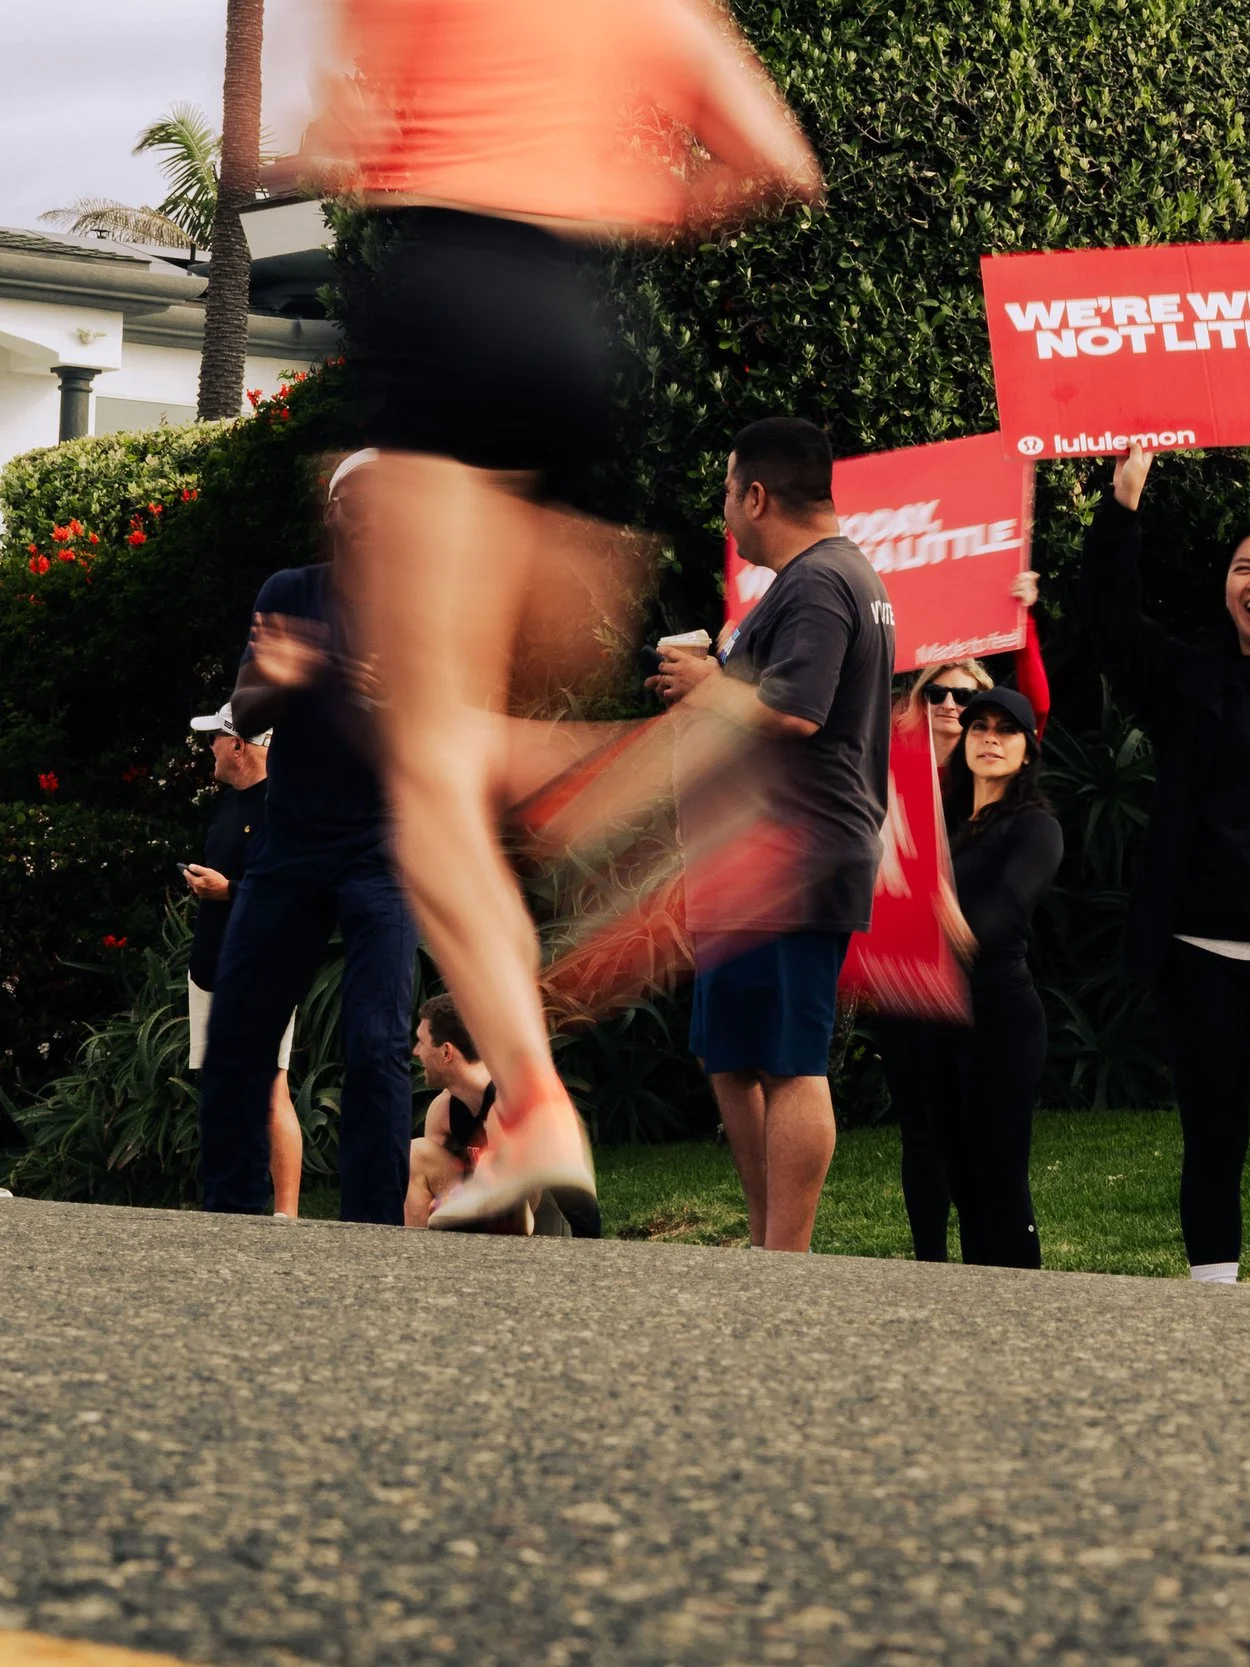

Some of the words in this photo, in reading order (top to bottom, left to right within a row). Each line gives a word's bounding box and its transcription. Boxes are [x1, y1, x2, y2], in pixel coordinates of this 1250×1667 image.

[1004, 296, 1184, 331] WE'RE
[1036, 324, 1155, 360] NOT
[1054, 430, 1196, 453] lululemon
